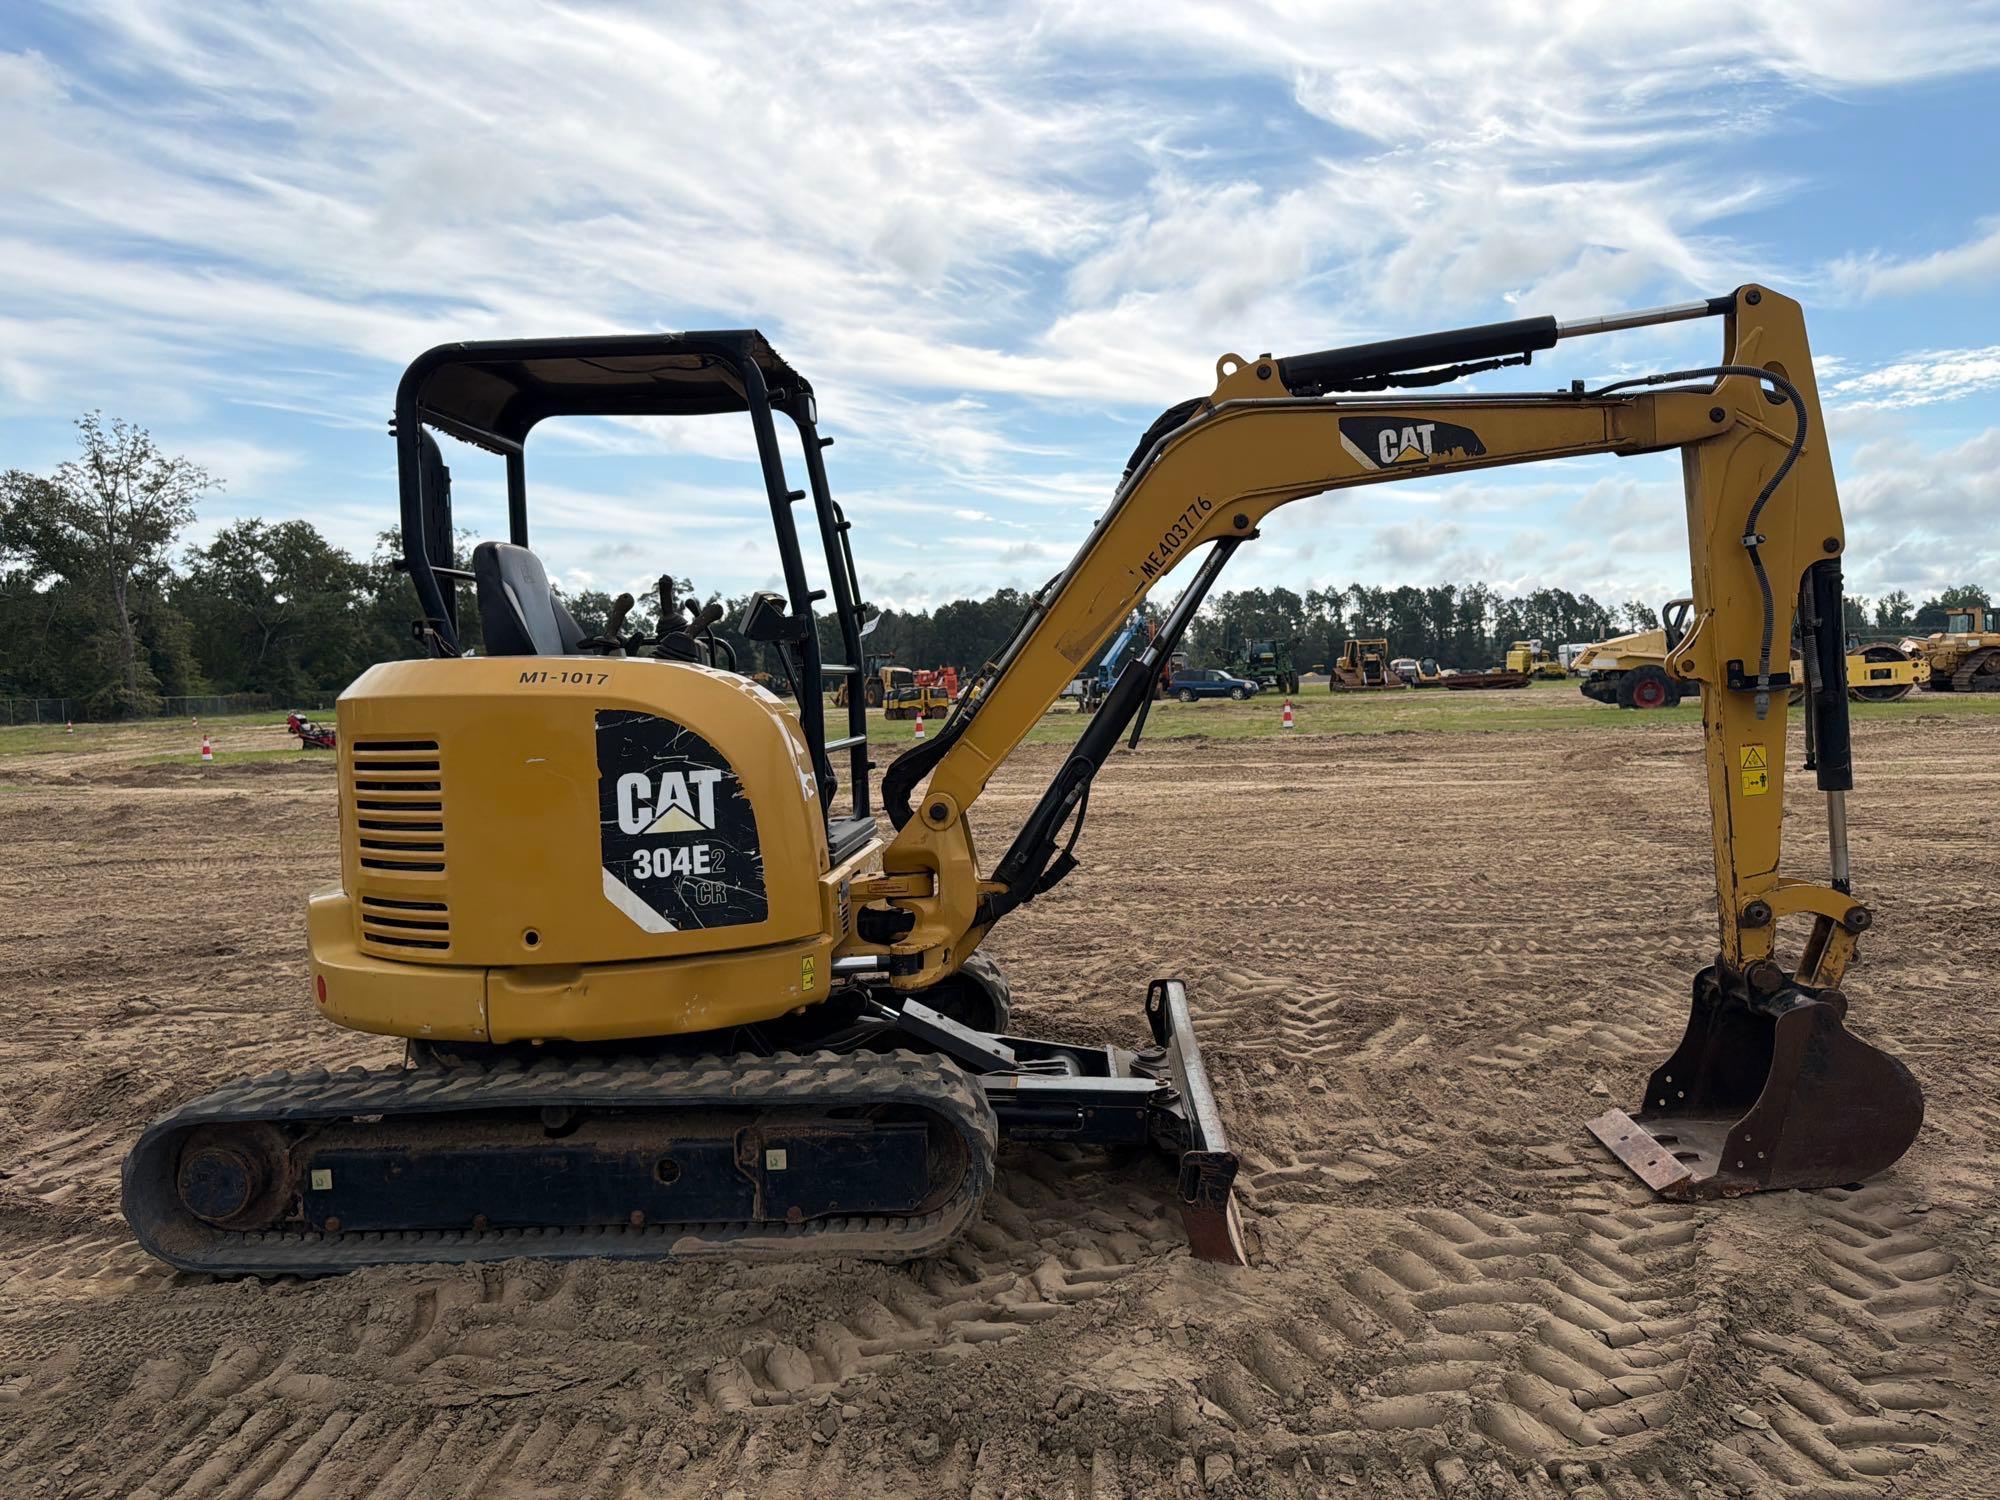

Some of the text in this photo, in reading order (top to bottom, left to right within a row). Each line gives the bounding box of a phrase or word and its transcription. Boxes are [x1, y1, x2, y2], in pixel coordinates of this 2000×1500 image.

[1378, 423, 1436, 464] CAT
[519, 671, 609, 686] M1-1017
[616, 768, 722, 836] CAT
[632, 844, 727, 880] 304E2
[695, 881, 728, 906] CR
